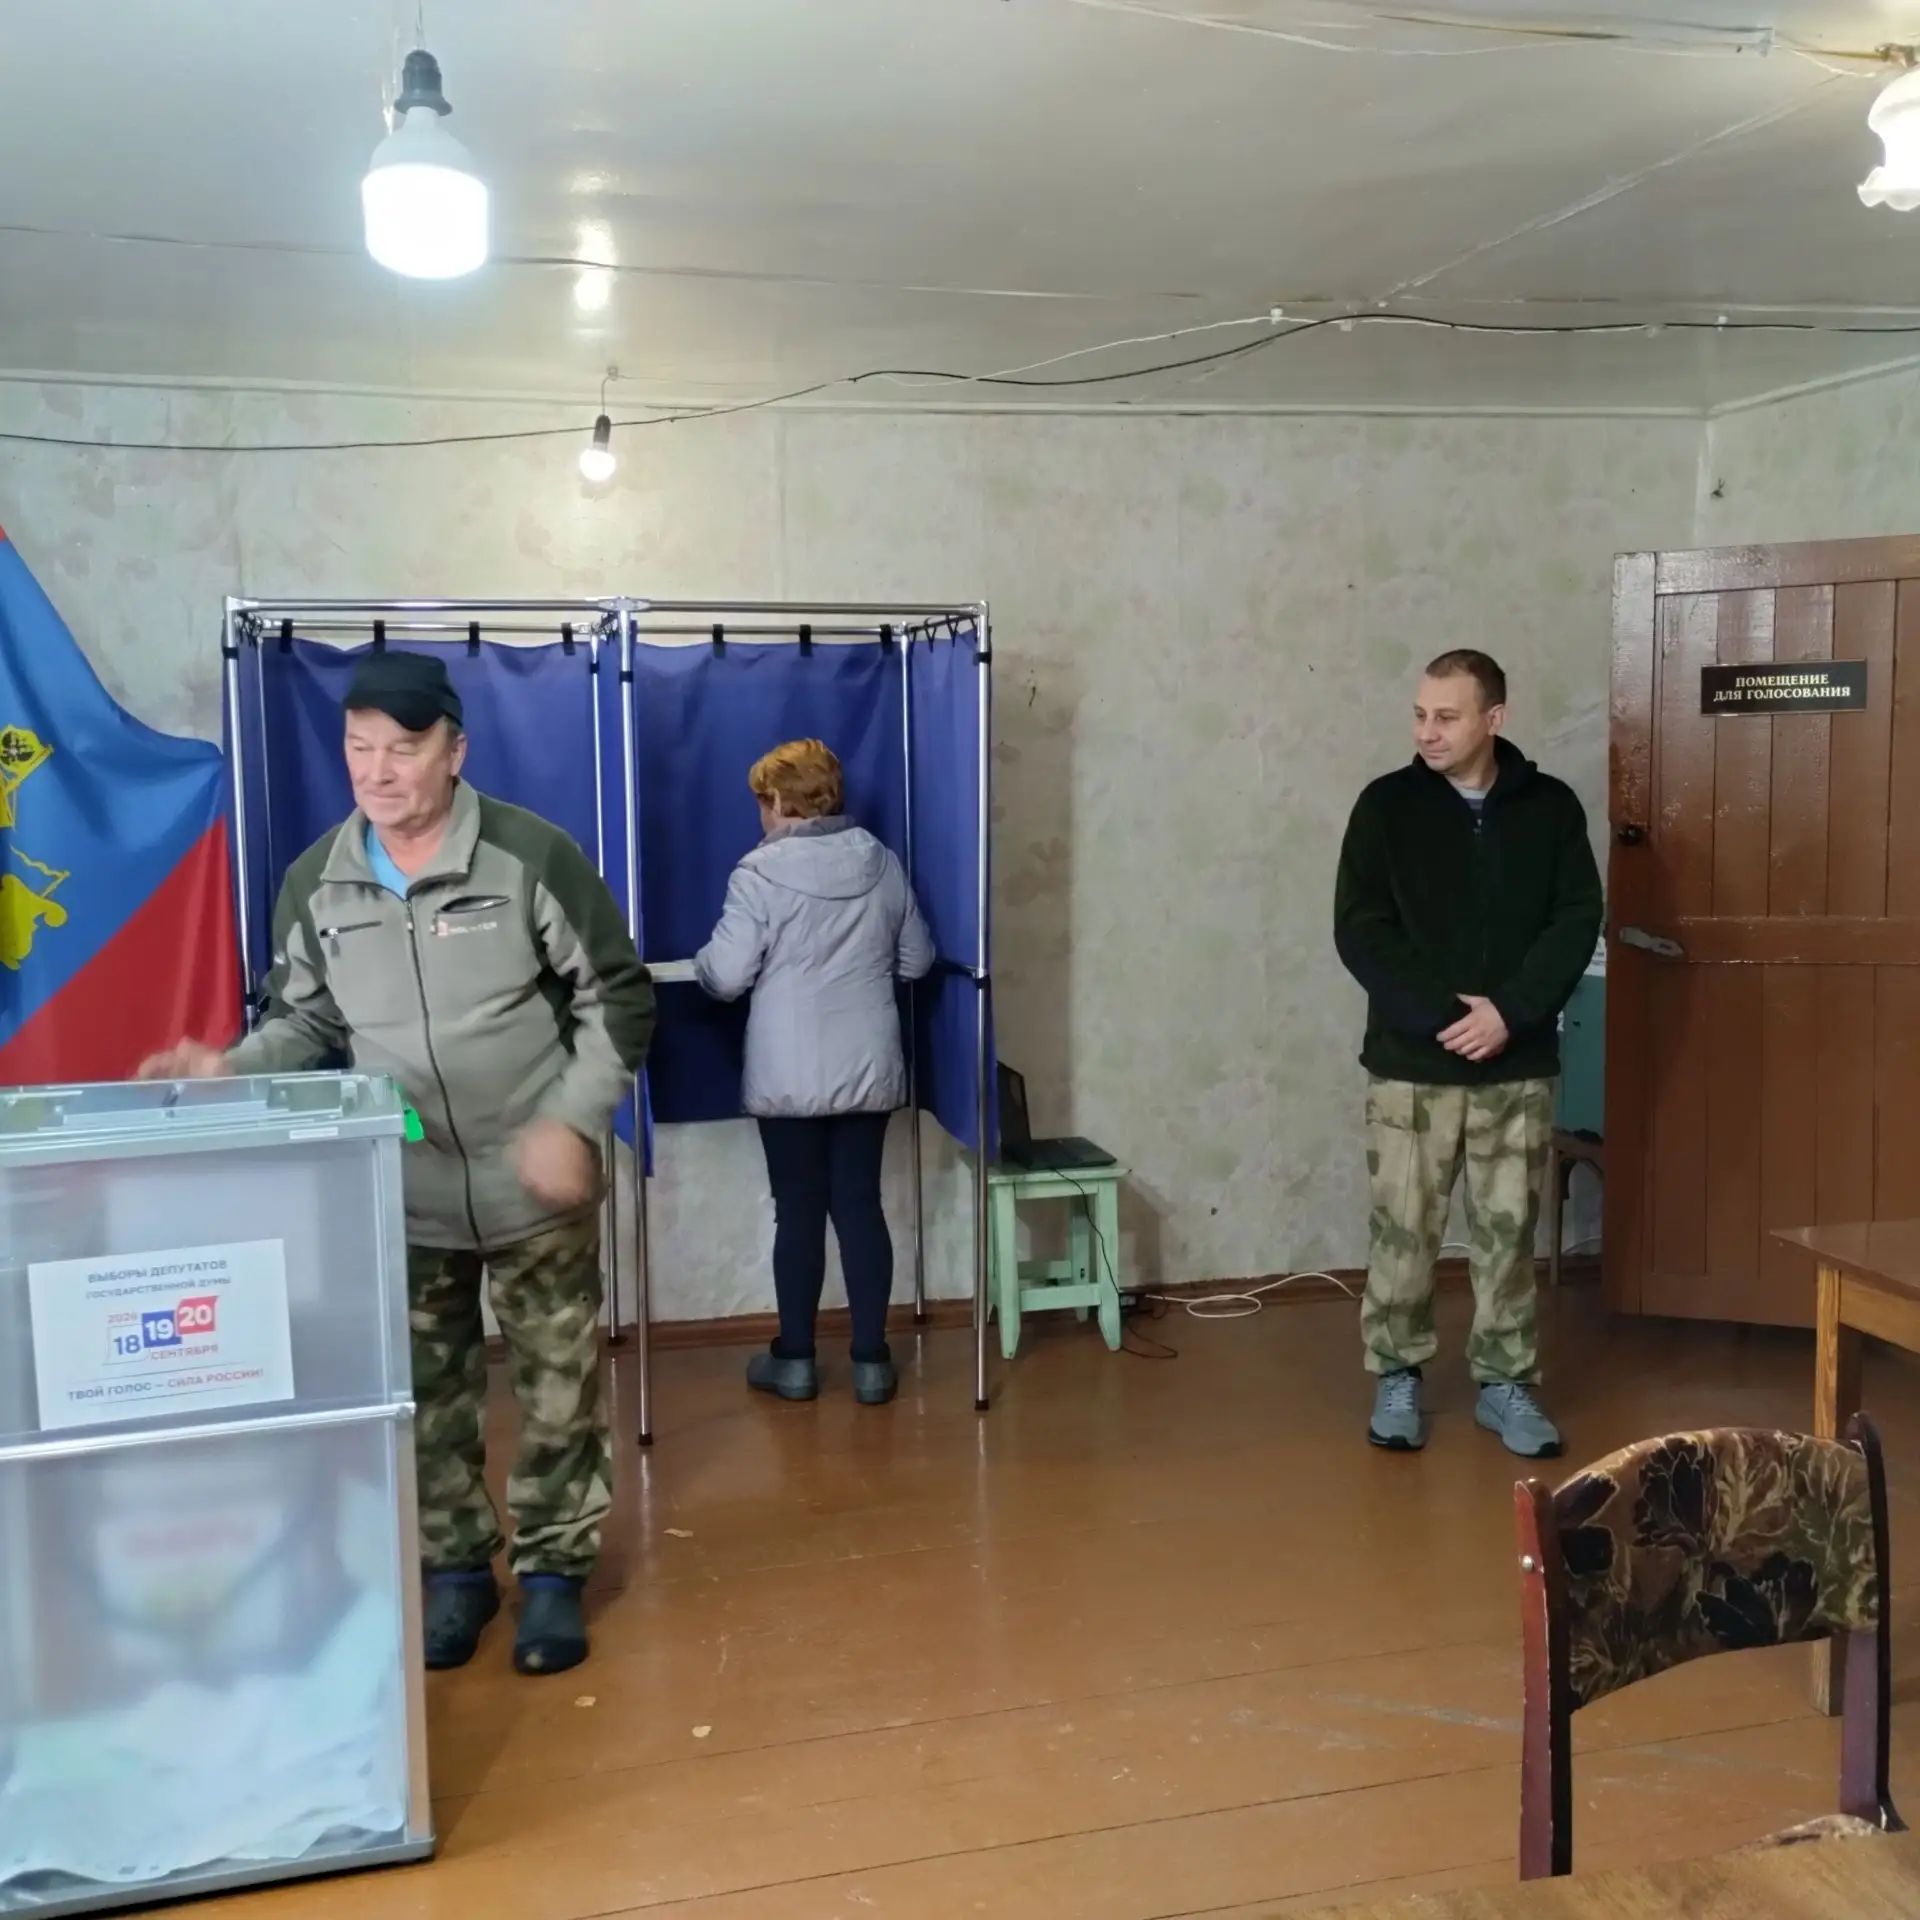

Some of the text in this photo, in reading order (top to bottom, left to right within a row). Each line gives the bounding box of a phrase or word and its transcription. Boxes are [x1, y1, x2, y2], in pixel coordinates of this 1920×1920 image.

[1735, 673, 1829, 688] ПОМЕЩЕНИЕ
[1713, 686, 1851, 702] ДЛЯ ГОЛОСОВАНИЯ
[88, 1260, 227, 1283] ВЫБОРЫ ДЕПУТАТОВ
[86, 1277, 231, 1299] ГОСУДАРСТВЕННОЙ ДУМЫ
[113, 1304, 212, 1355] 18 19 20
[151, 1344, 218, 1360] СЕНТЯБРЯ
[68, 1386, 103, 1401] ТВОЙ
[108, 1382, 151, 1396] ГОЛОС
[168, 1377, 203, 1388] СИЛА
[206, 1368, 264, 1383] РОССИИ!
